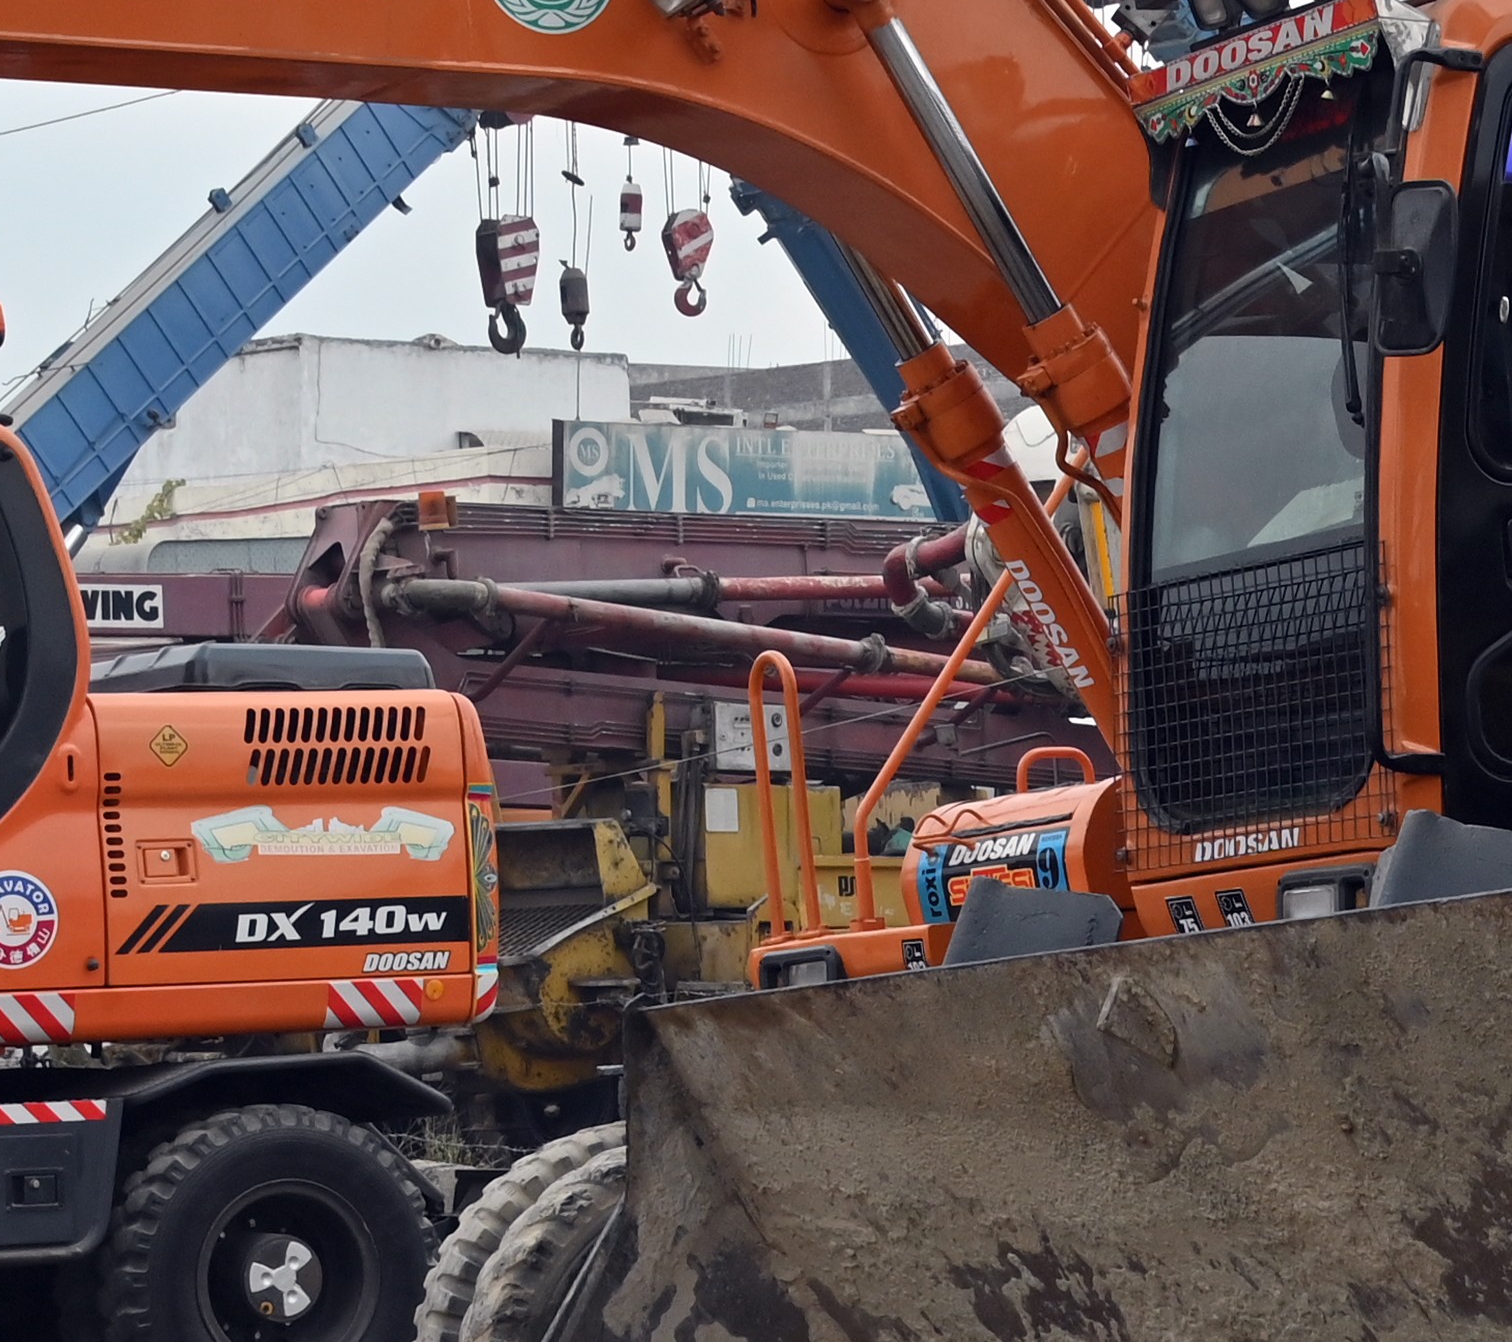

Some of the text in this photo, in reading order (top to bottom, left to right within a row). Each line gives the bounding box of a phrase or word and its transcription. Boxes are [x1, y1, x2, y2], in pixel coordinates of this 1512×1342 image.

[1166, 4, 1335, 93] DOOSAN
[579, 443, 600, 459] MS
[625, 434, 734, 514] MS
[1005, 560, 1095, 689] DOOSAN
[253, 832, 402, 844] CITYWIDE
[949, 832, 1036, 867] DOOSAN
[1194, 827, 1300, 863] DOOSAN
[235, 902, 316, 943] DX
[362, 951, 451, 973] DOOSAN
